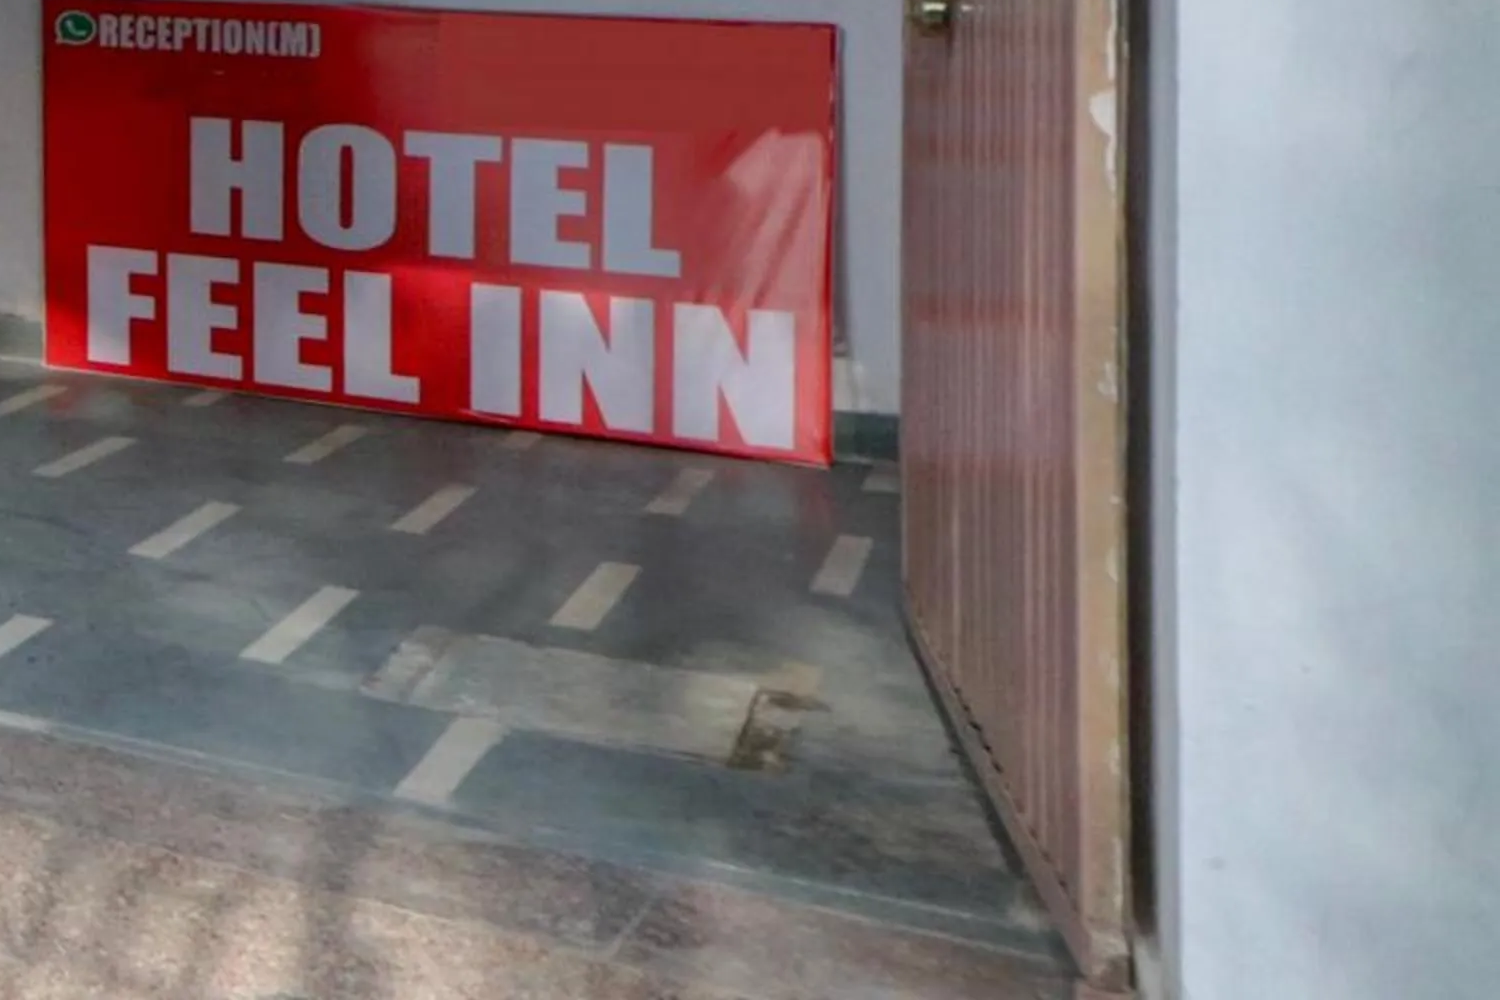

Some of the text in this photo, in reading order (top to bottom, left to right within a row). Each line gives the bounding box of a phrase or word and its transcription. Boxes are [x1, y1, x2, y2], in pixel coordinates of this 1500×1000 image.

[189, 116, 681, 277] HOTEL
[86, 244, 796, 450] FEEL INN
